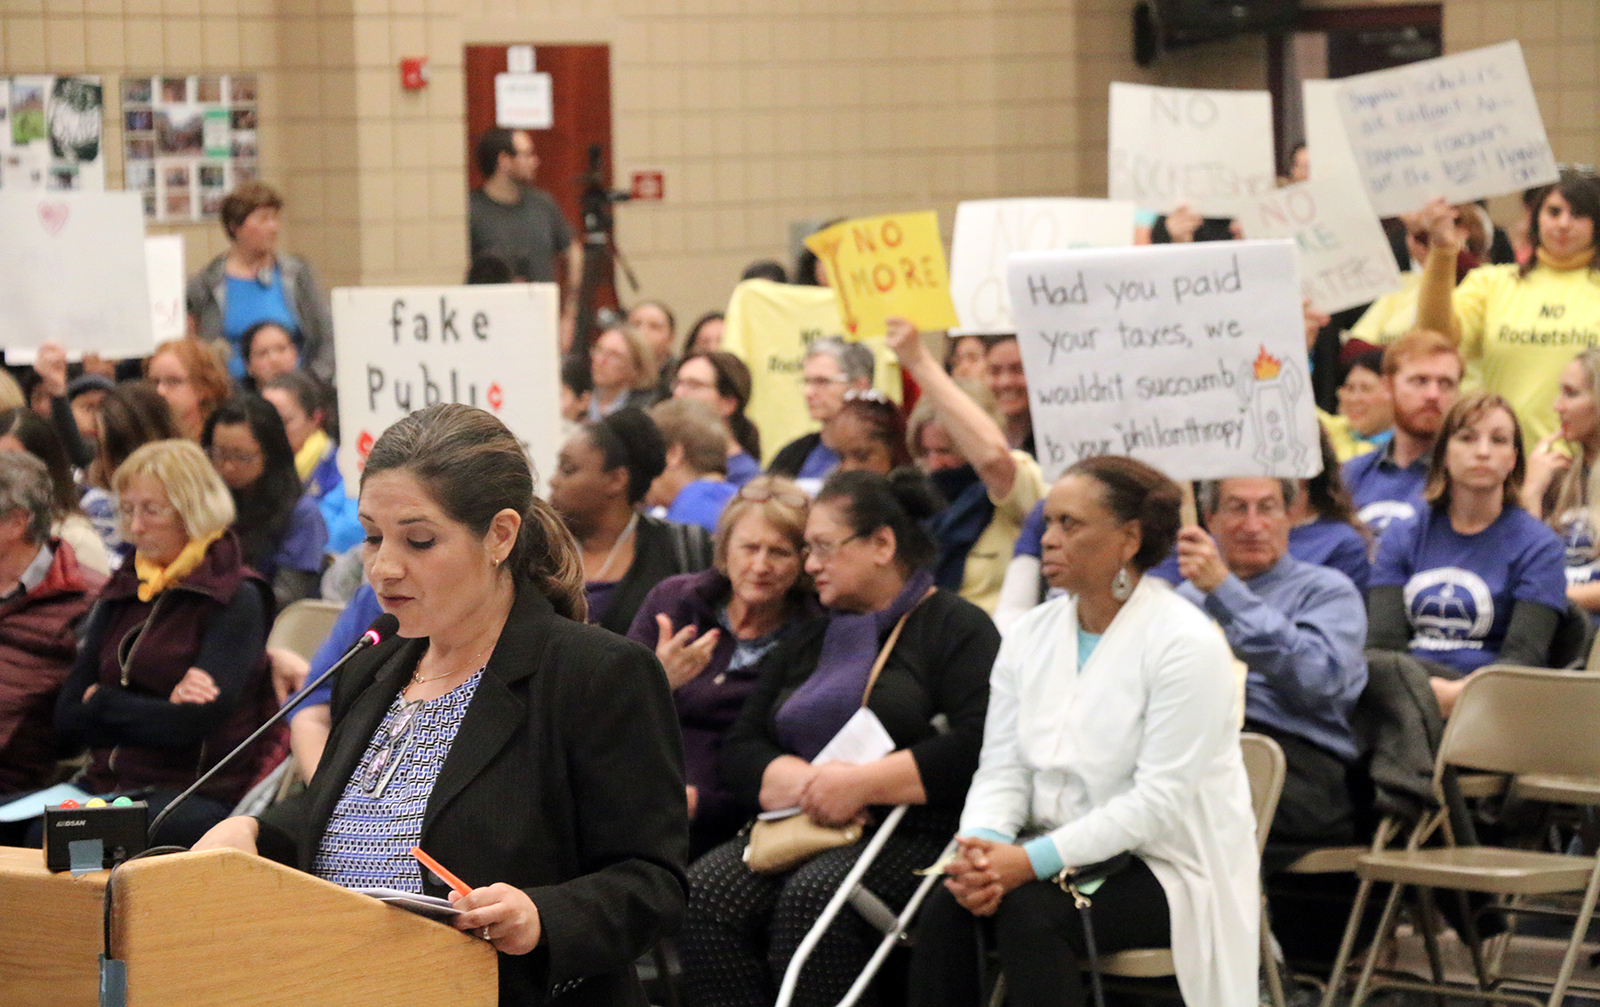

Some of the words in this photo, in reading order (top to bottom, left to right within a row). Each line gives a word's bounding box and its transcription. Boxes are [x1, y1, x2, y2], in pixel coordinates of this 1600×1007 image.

[1259, 188, 1317, 230] NO
[852, 220, 903, 253] NO
[850, 256, 939, 297] MORE
[1028, 270, 1088, 305] Had
[1105, 280, 1157, 310] you
[1172, 253, 1241, 304] paid
[1539, 303, 1566, 319] NO
[1041, 328, 1100, 365] your
[1118, 320, 1193, 349] taxes,
[1205, 319, 1243, 339] we
[1499, 325, 1598, 348] Rocketship
[1136, 357, 1235, 400] succumb
[1045, 433, 1064, 462] to
